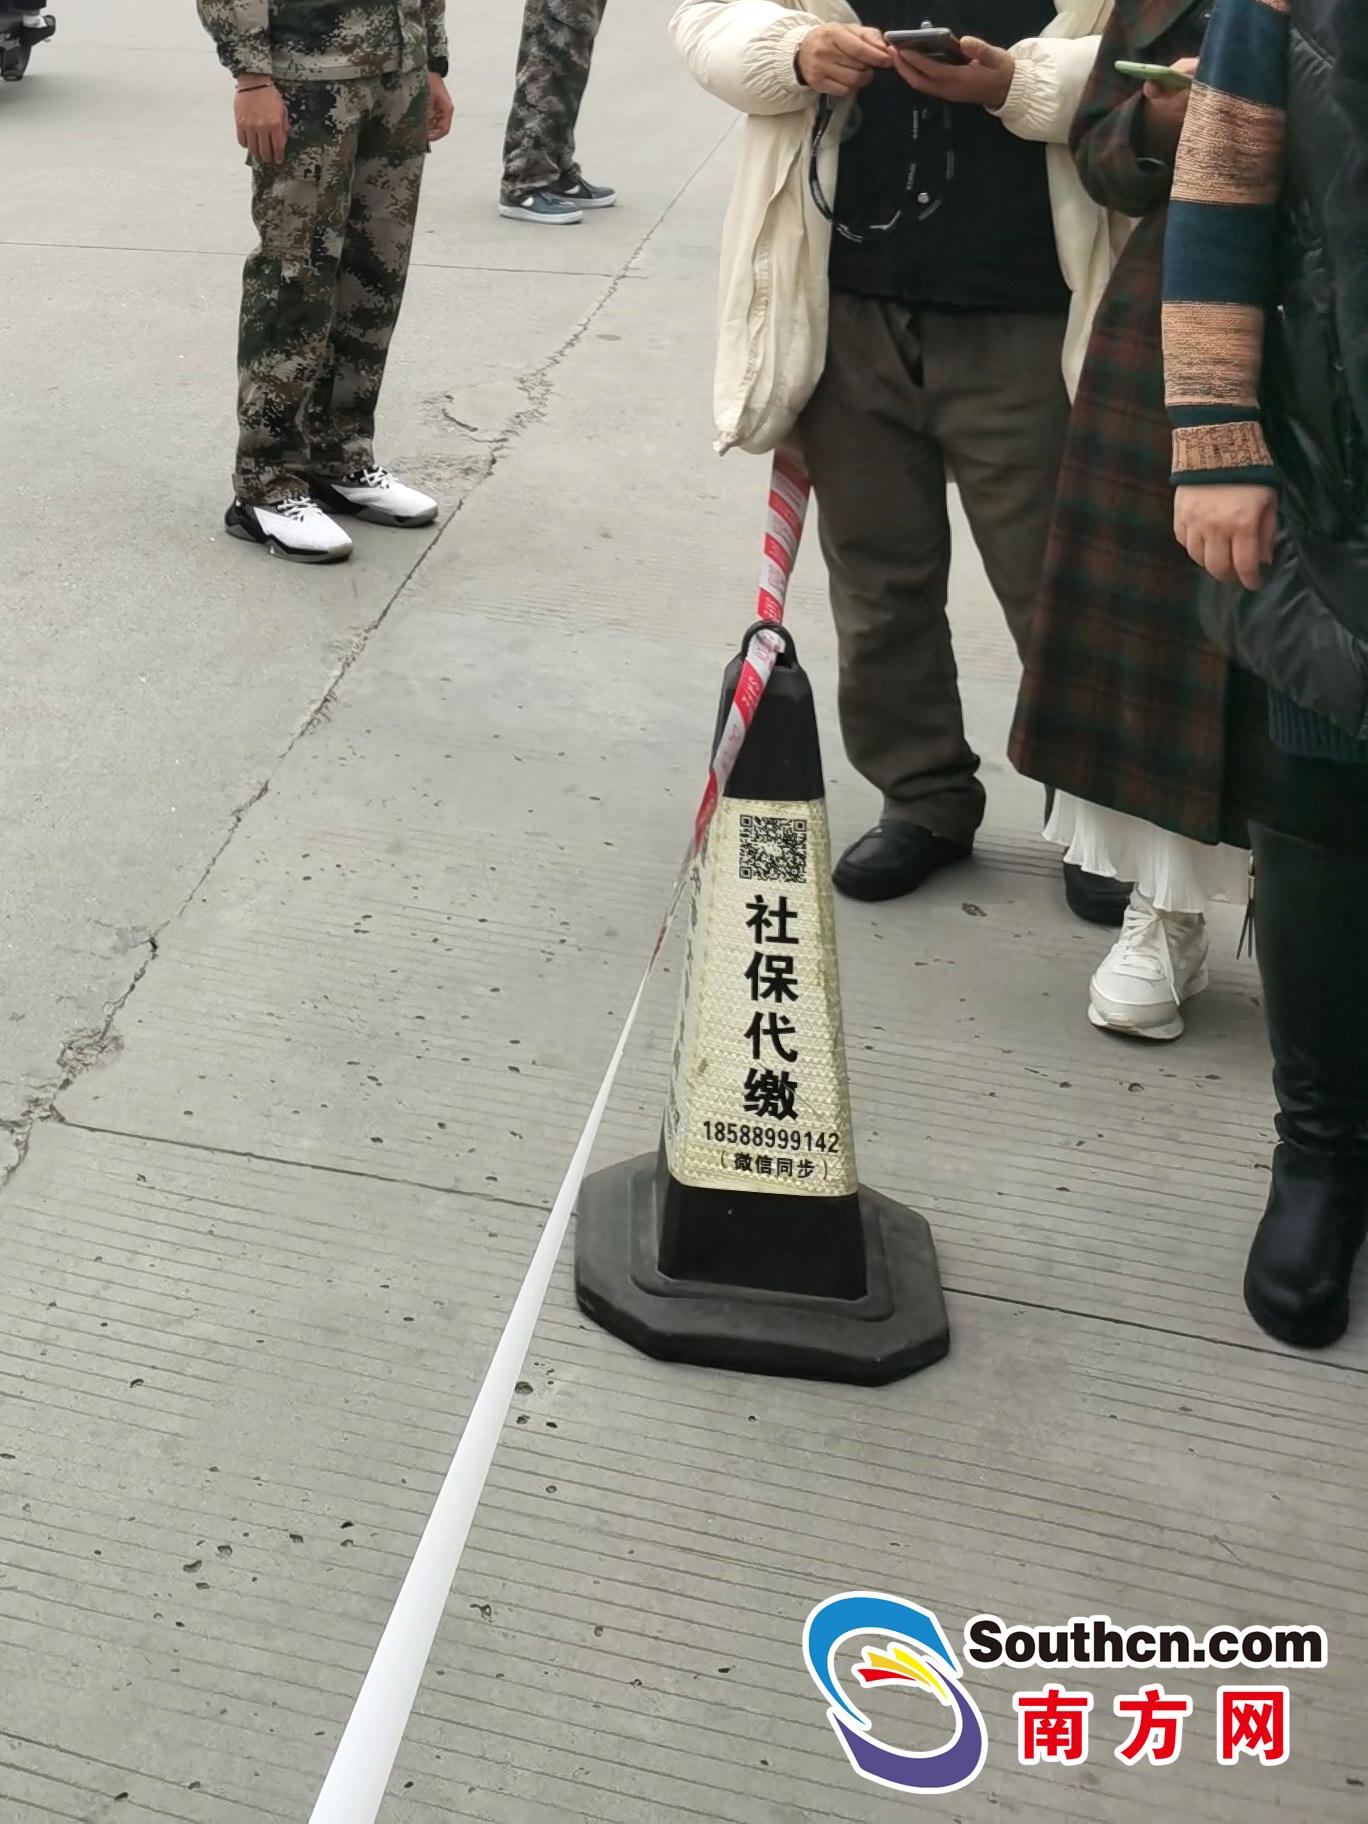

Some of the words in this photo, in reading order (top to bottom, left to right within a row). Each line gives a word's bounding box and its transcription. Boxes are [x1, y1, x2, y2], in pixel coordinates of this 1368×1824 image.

[744, 894, 800, 1122] 社保代缴
[703, 1121, 840, 1154] 18588999142
